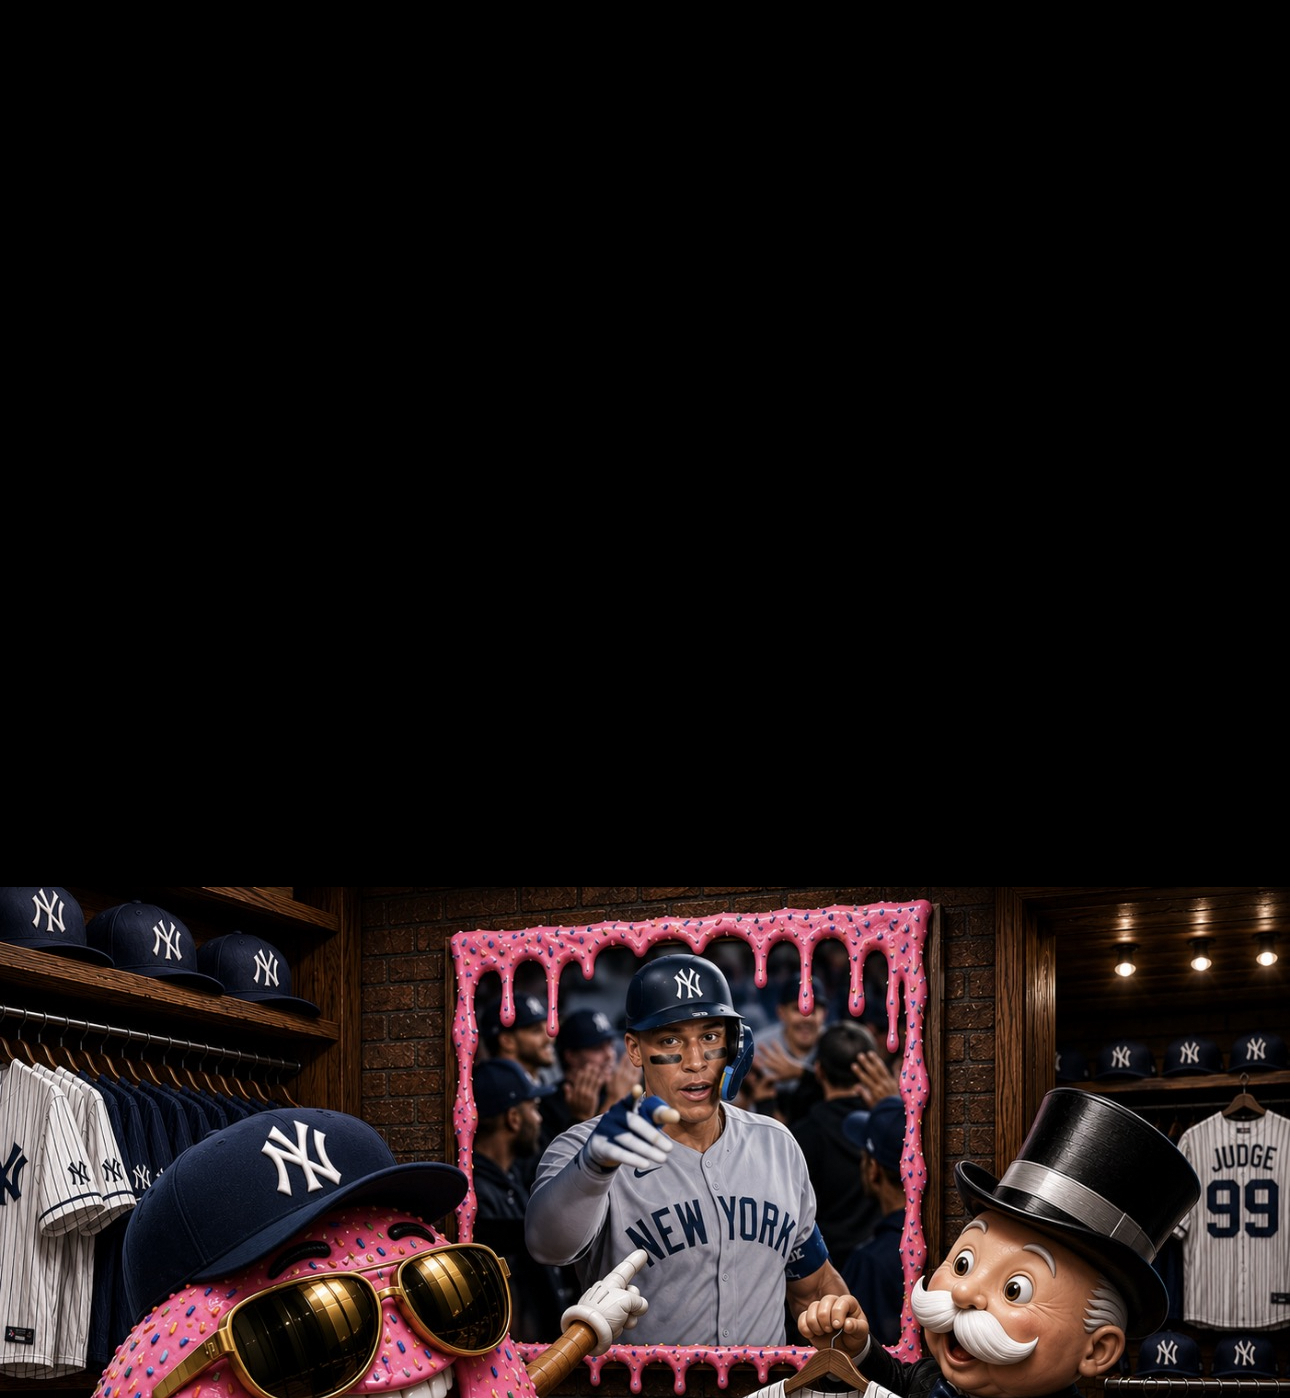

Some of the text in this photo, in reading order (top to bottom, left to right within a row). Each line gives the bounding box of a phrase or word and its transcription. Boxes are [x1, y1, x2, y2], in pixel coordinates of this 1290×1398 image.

[32, 888, 66, 933] NY
[152, 919, 183, 962] NY
[253, 949, 280, 987] NY
[673, 967, 704, 999] NY
[1111, 1046, 1131, 1068] NY
[1180, 1041, 1200, 1064] NY
[1246, 1037, 1266, 1060] NY
[67, 1160, 91, 1185] NY
[101, 1157, 124, 1183] NY
[261, 1120, 342, 1196] NY
[1211, 1144, 1278, 1173] JUDGE
[1206, 1178, 1280, 1238] 99
[625, 1195, 797, 1268] NEW YORK
[1156, 1339, 1178, 1366] NY
[1234, 1339, 1255, 1366] NY
